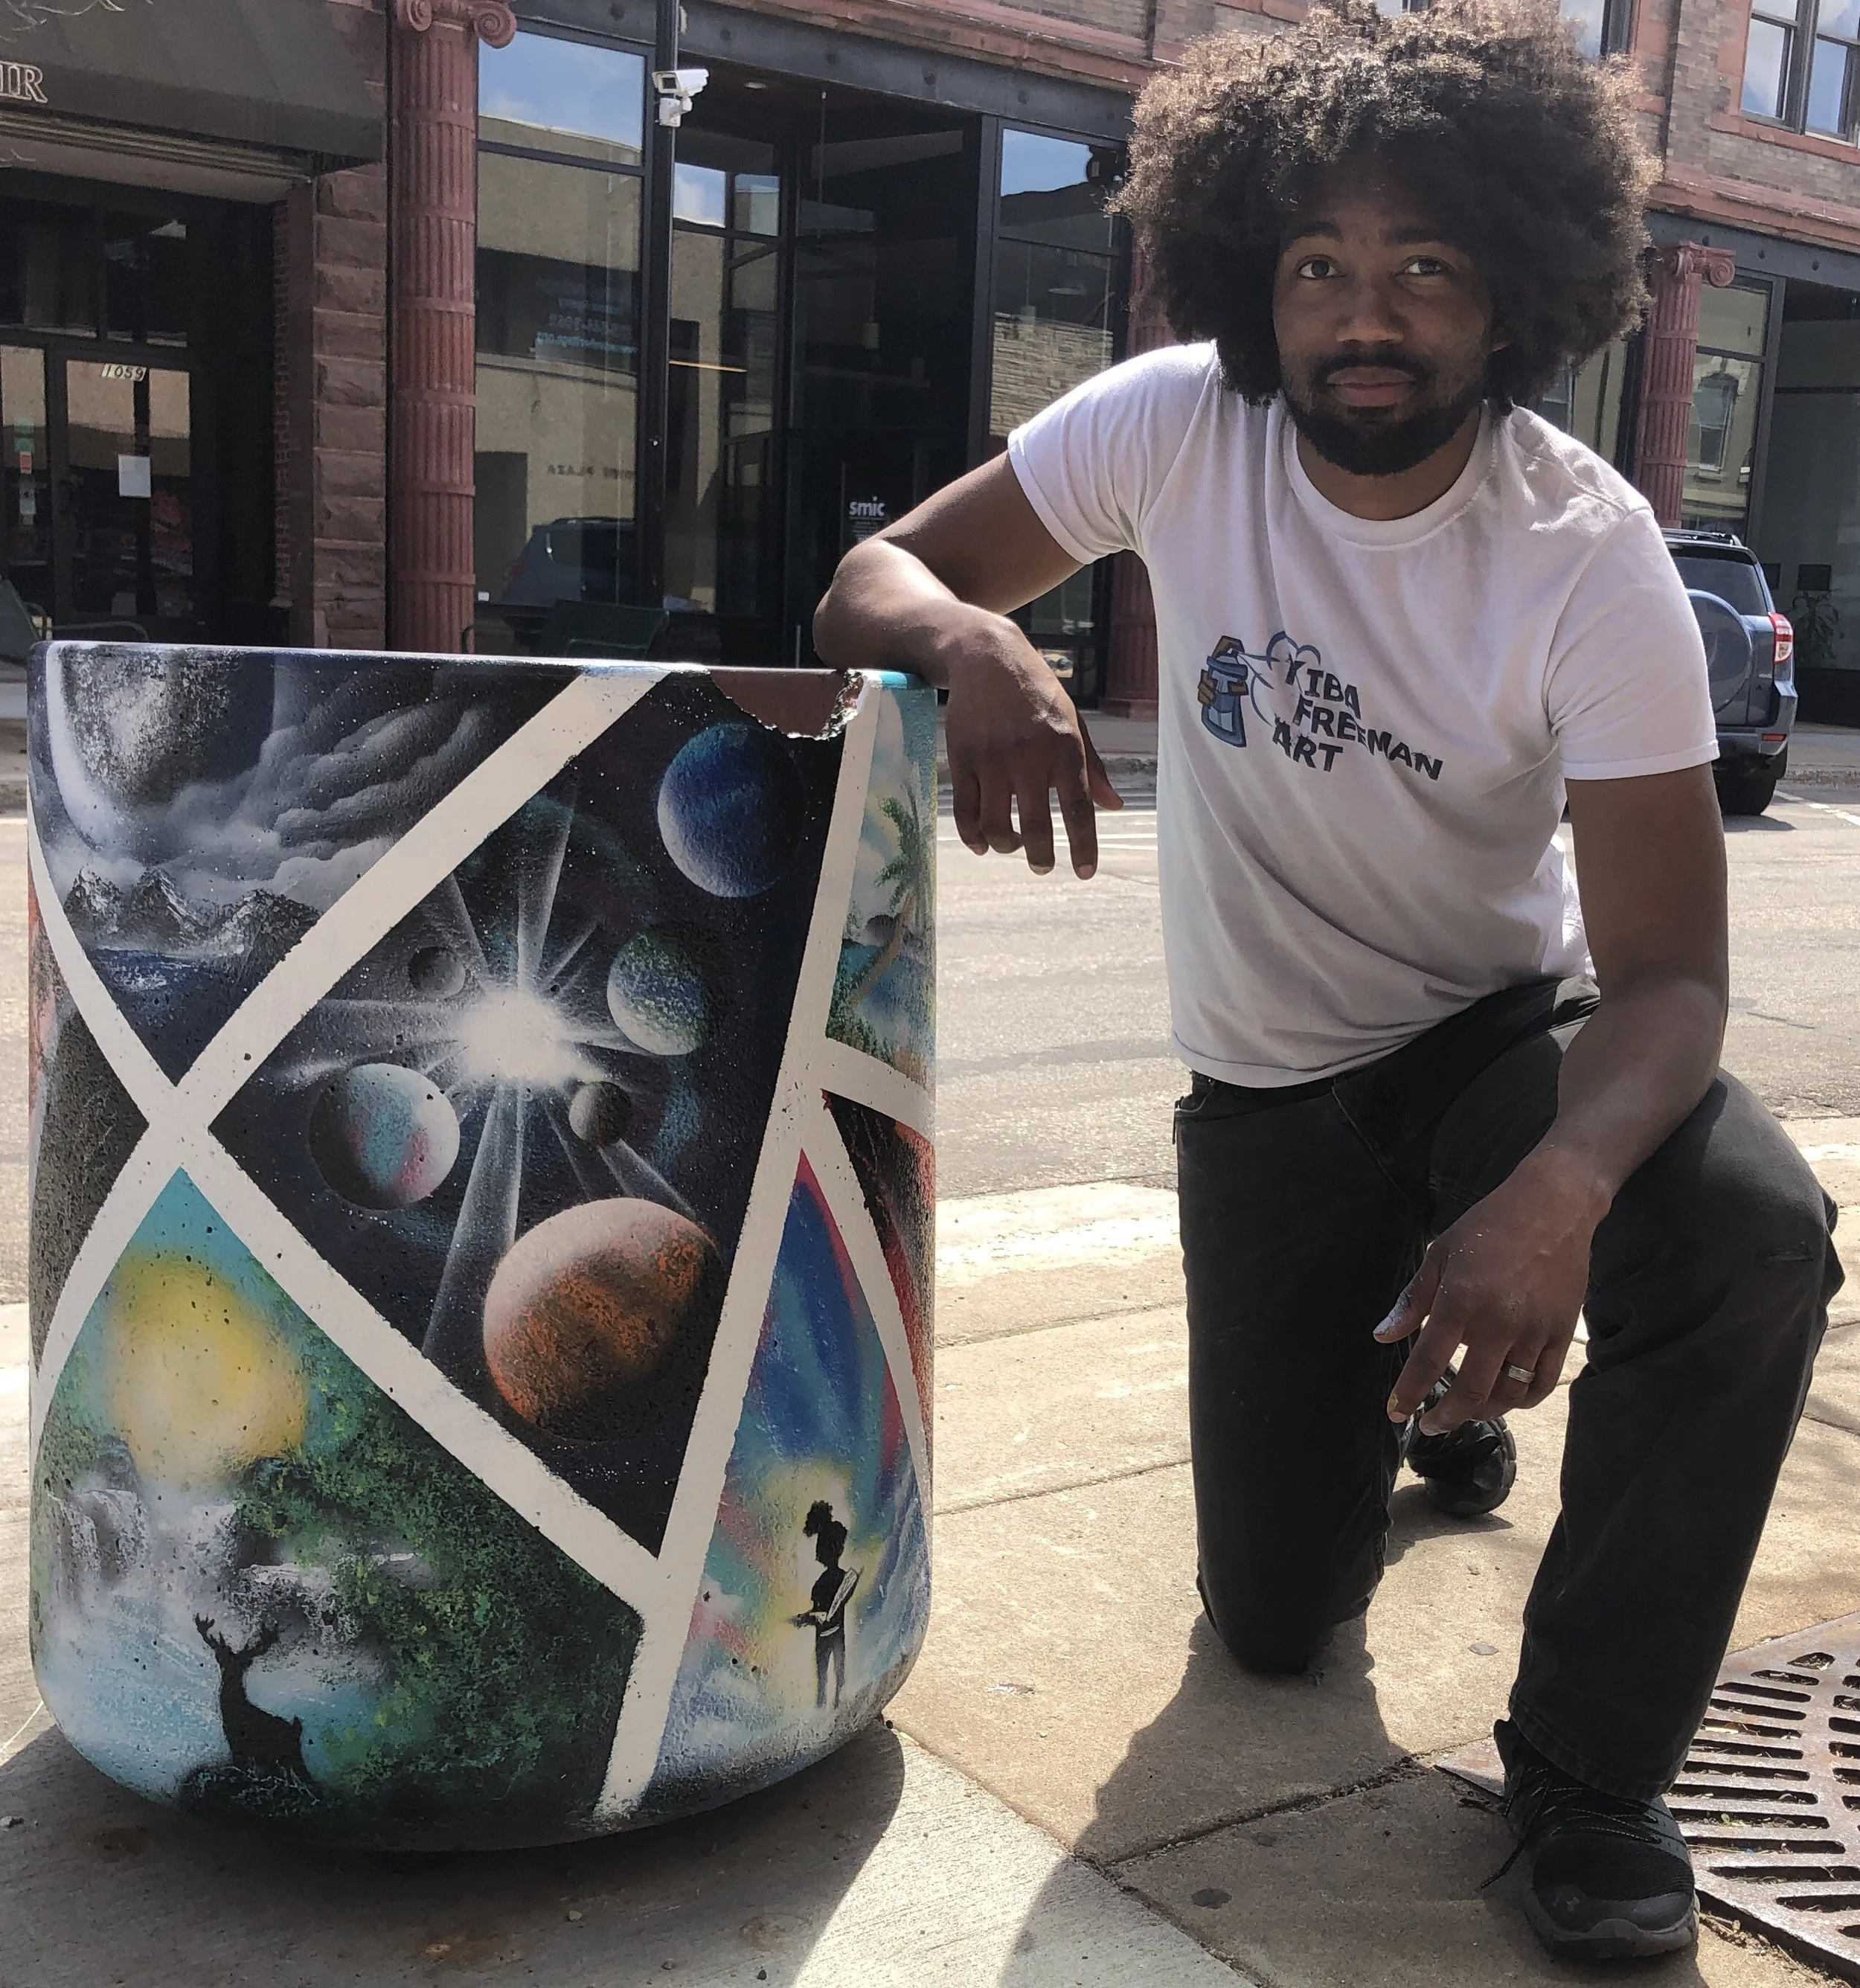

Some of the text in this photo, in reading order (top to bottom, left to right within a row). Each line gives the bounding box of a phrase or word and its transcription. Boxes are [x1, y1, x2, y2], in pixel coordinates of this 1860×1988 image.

[106, 364, 144, 381] 1059
[849, 496, 885, 516] smic
[1284, 652, 1361, 719] YIBA
[1272, 714, 1343, 772] ART
[1292, 693, 1443, 780] FREEMAN
